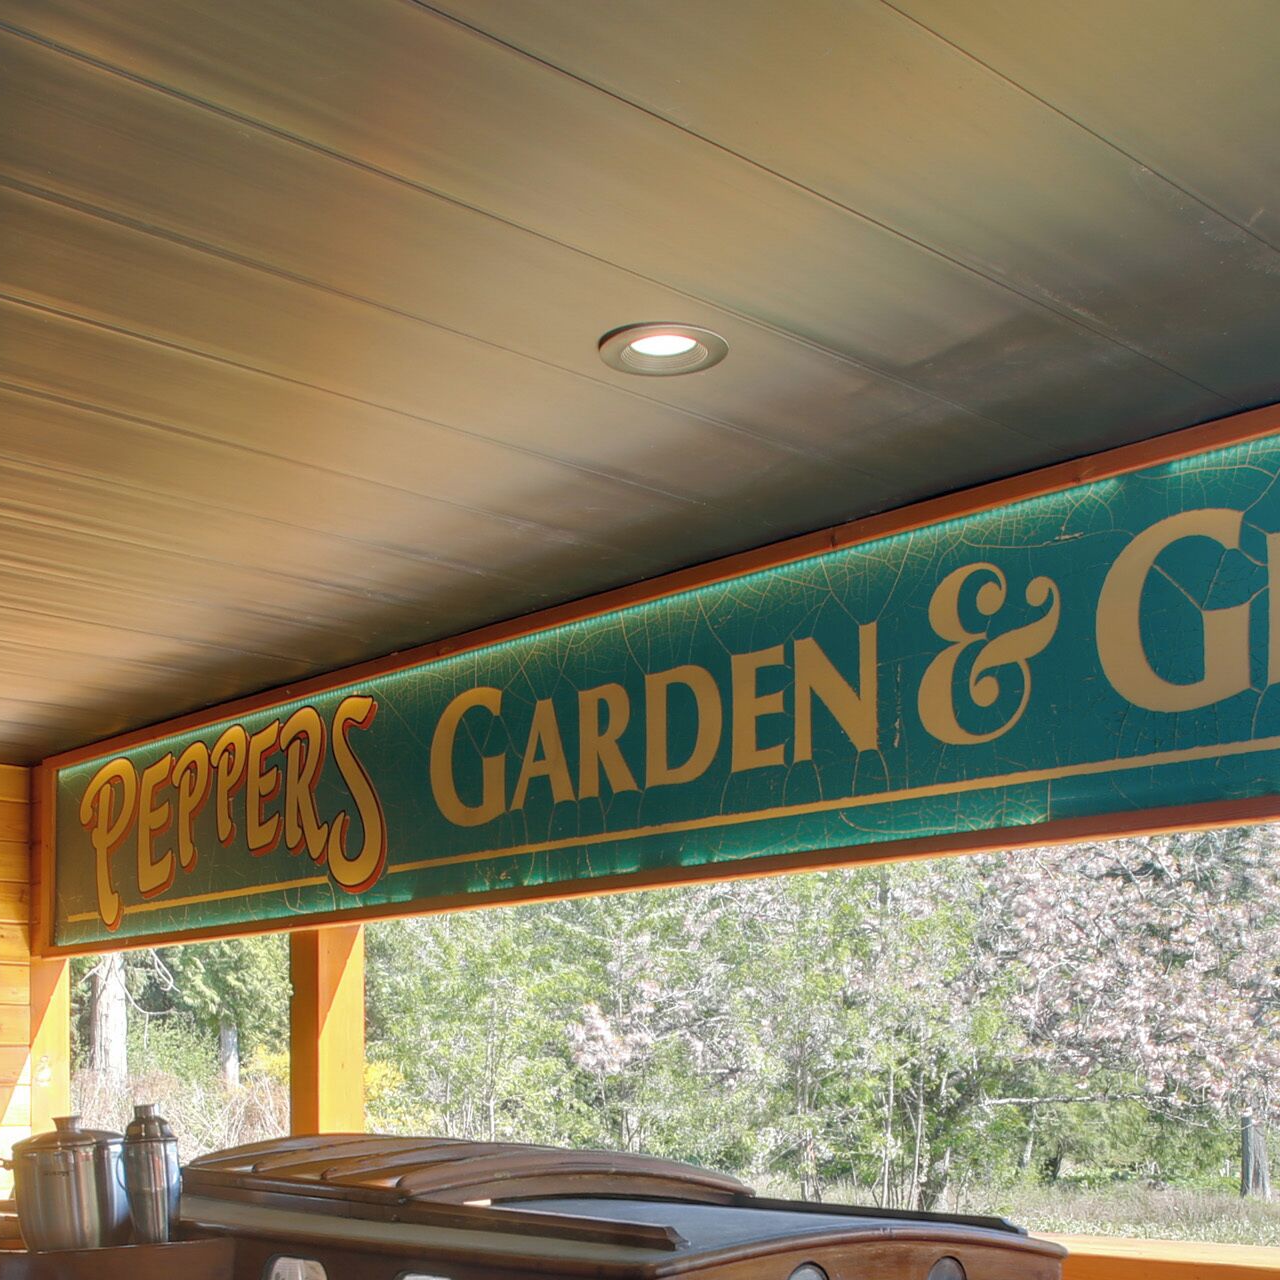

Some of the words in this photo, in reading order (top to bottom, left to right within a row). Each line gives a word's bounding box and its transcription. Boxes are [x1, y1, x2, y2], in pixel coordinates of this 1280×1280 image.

[80, 695, 387, 932] PEPPERS
[430, 621, 878, 827] GARDEN
[917, 562, 1060, 746] &
